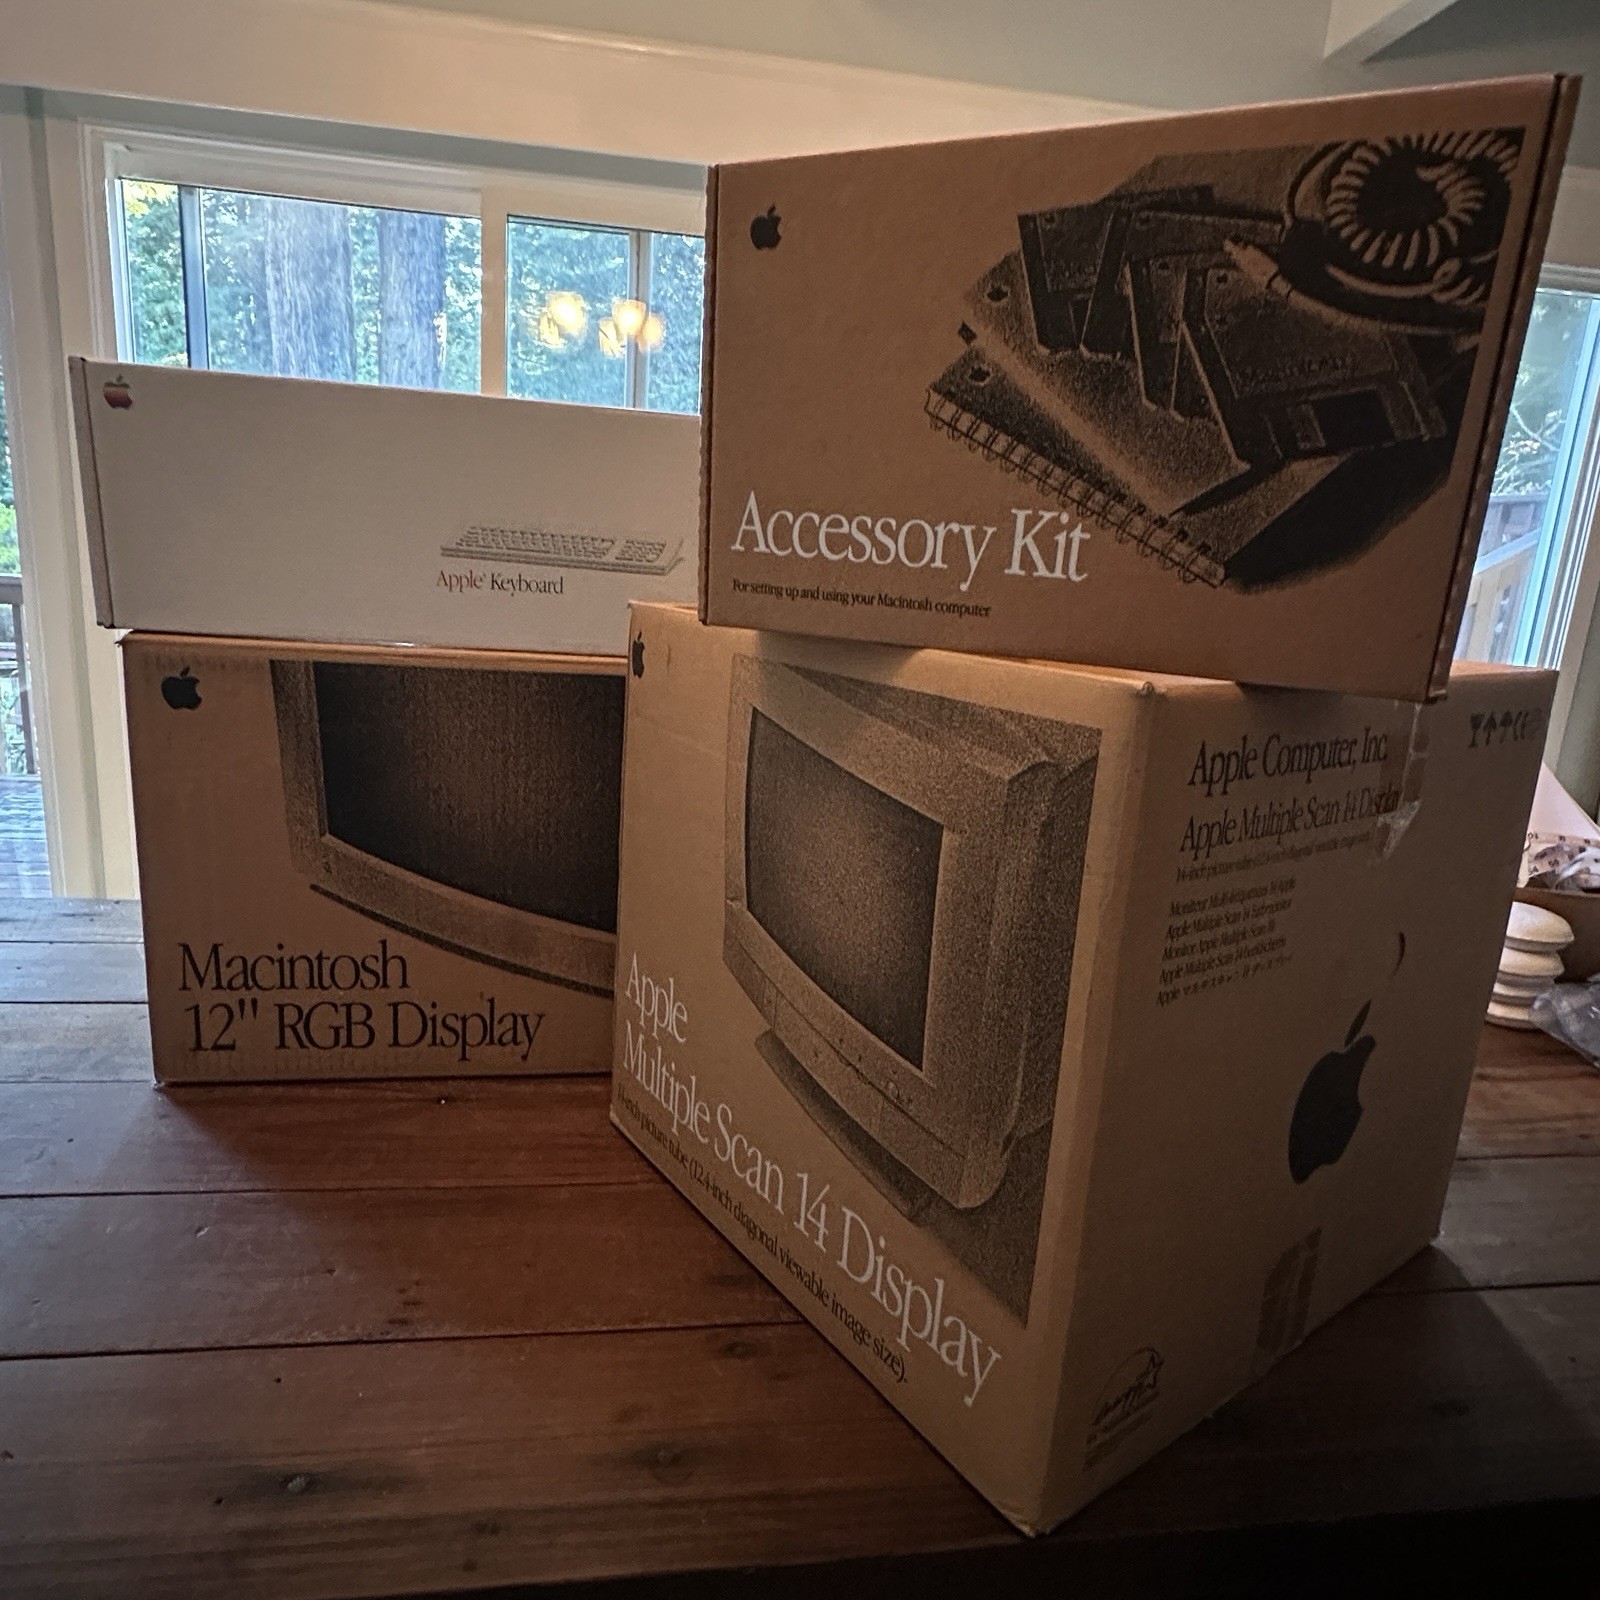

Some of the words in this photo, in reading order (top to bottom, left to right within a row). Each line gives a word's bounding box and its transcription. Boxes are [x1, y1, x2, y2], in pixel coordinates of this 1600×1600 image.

[730, 490, 998, 592] Accessory
[1004, 508, 1091, 582] Kit
[437, 569, 484, 593] Apple
[490, 572, 564, 596] Keyboard
[732, 578, 749, 593] For
[750, 582, 784, 600] setting
[785, 586, 799, 601] up
[800, 586, 820, 602] and
[822, 589, 849, 606] using
[851, 593, 876, 608] your
[877, 592, 933, 613] Macintosh
[934, 599, 992, 618] computer
[1187, 734, 1258, 797] Apple
[1262, 732, 1359, 785] Computer,
[1180, 808, 1237, 861] Apple
[1238, 797, 1304, 846] Multiple
[1304, 796, 1339, 831] Scan
[177, 939, 411, 992] Macintosh
[625, 951, 688, 1043] Apple
[185, 997, 258, 1053] 12"
[273, 1000, 376, 1051] RGB
[387, 997, 545, 1062] Display
[623, 1021, 710, 1145] Multiple
[715, 1104, 784, 1215] Scan
[794, 1171, 829, 1253] 14
[837, 1205, 1002, 1407] Display
[668, 1138, 688, 1169] tube
[733, 1199, 777, 1259] diagonal
[778, 1248, 829, 1307] viewable
[831, 1292, 871, 1349] image
